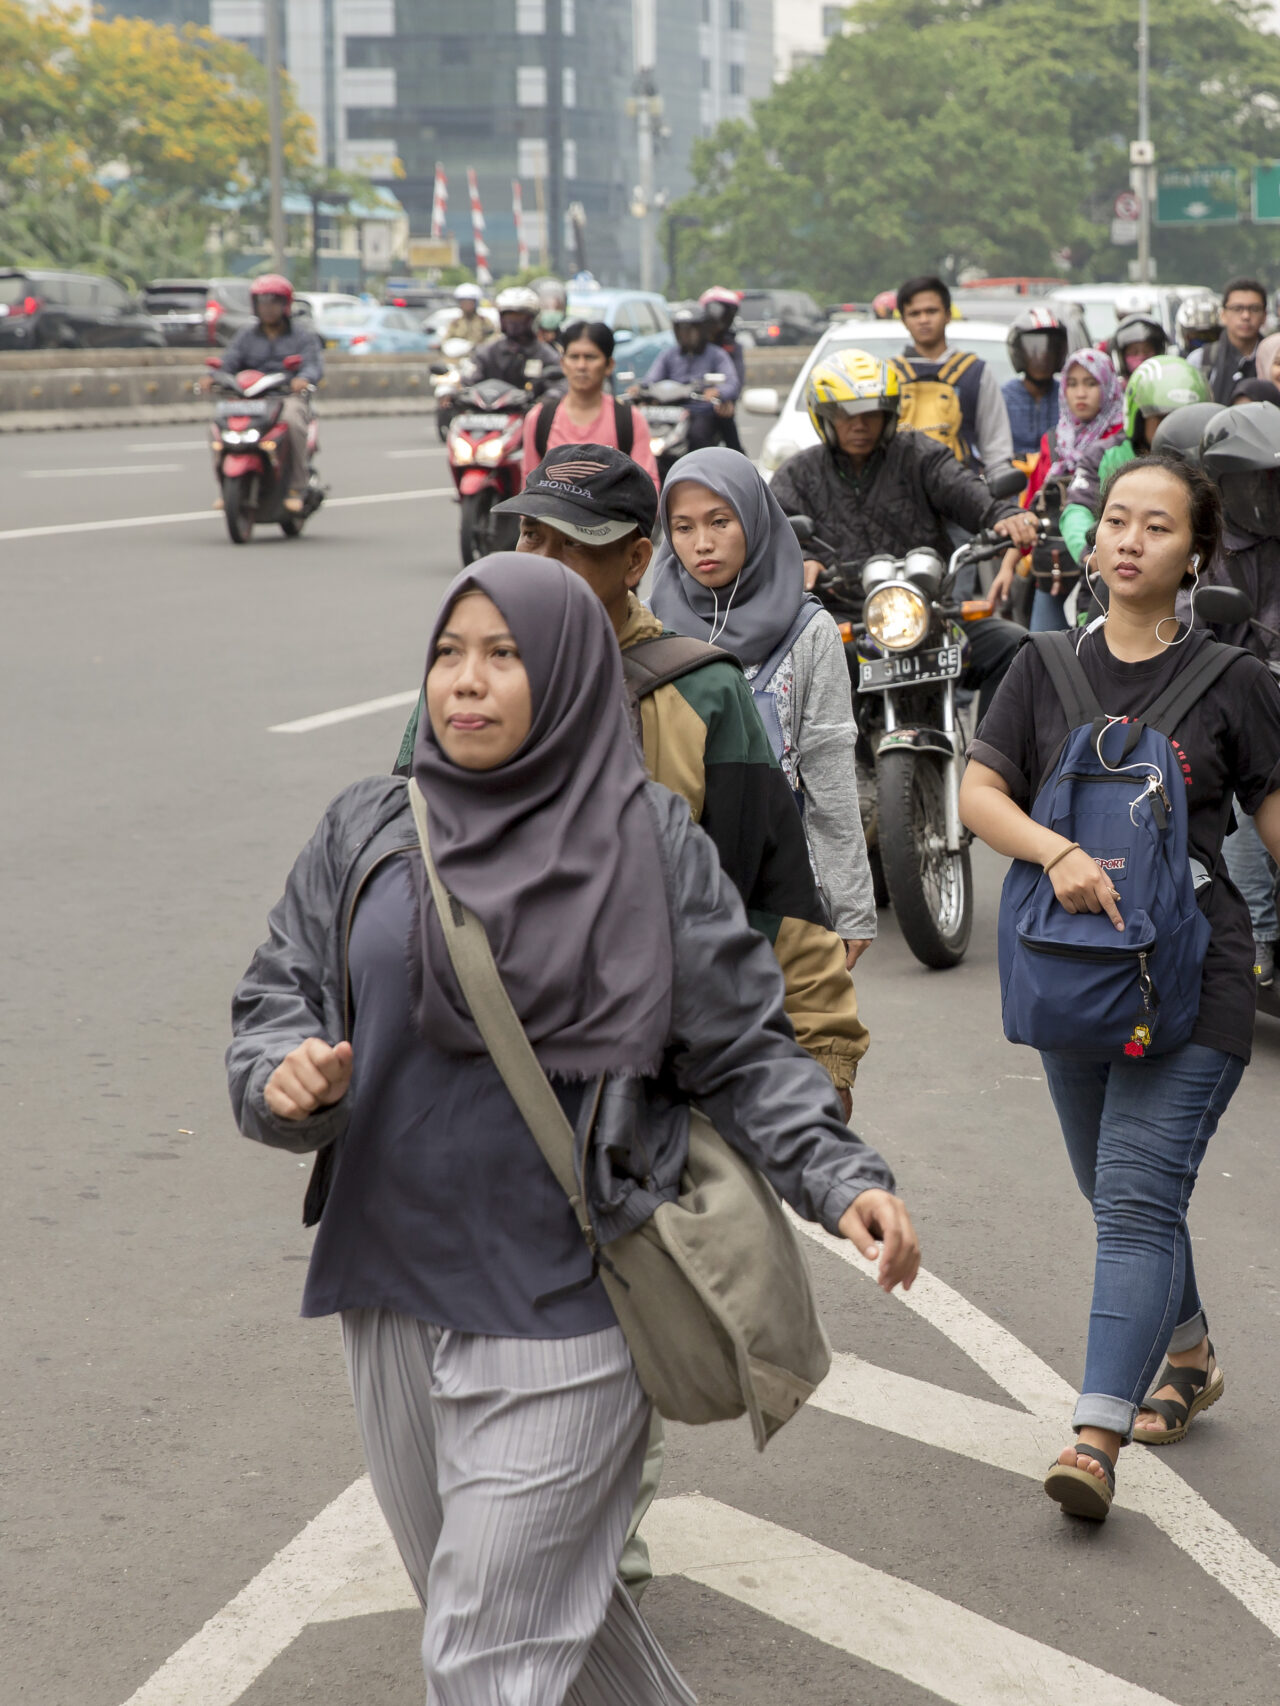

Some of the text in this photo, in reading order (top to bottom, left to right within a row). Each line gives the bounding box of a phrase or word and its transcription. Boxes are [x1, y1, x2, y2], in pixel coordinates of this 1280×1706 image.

[537, 479, 594, 500] HONDA
[863, 665, 873, 681] B
[938, 648, 957, 667] GE
